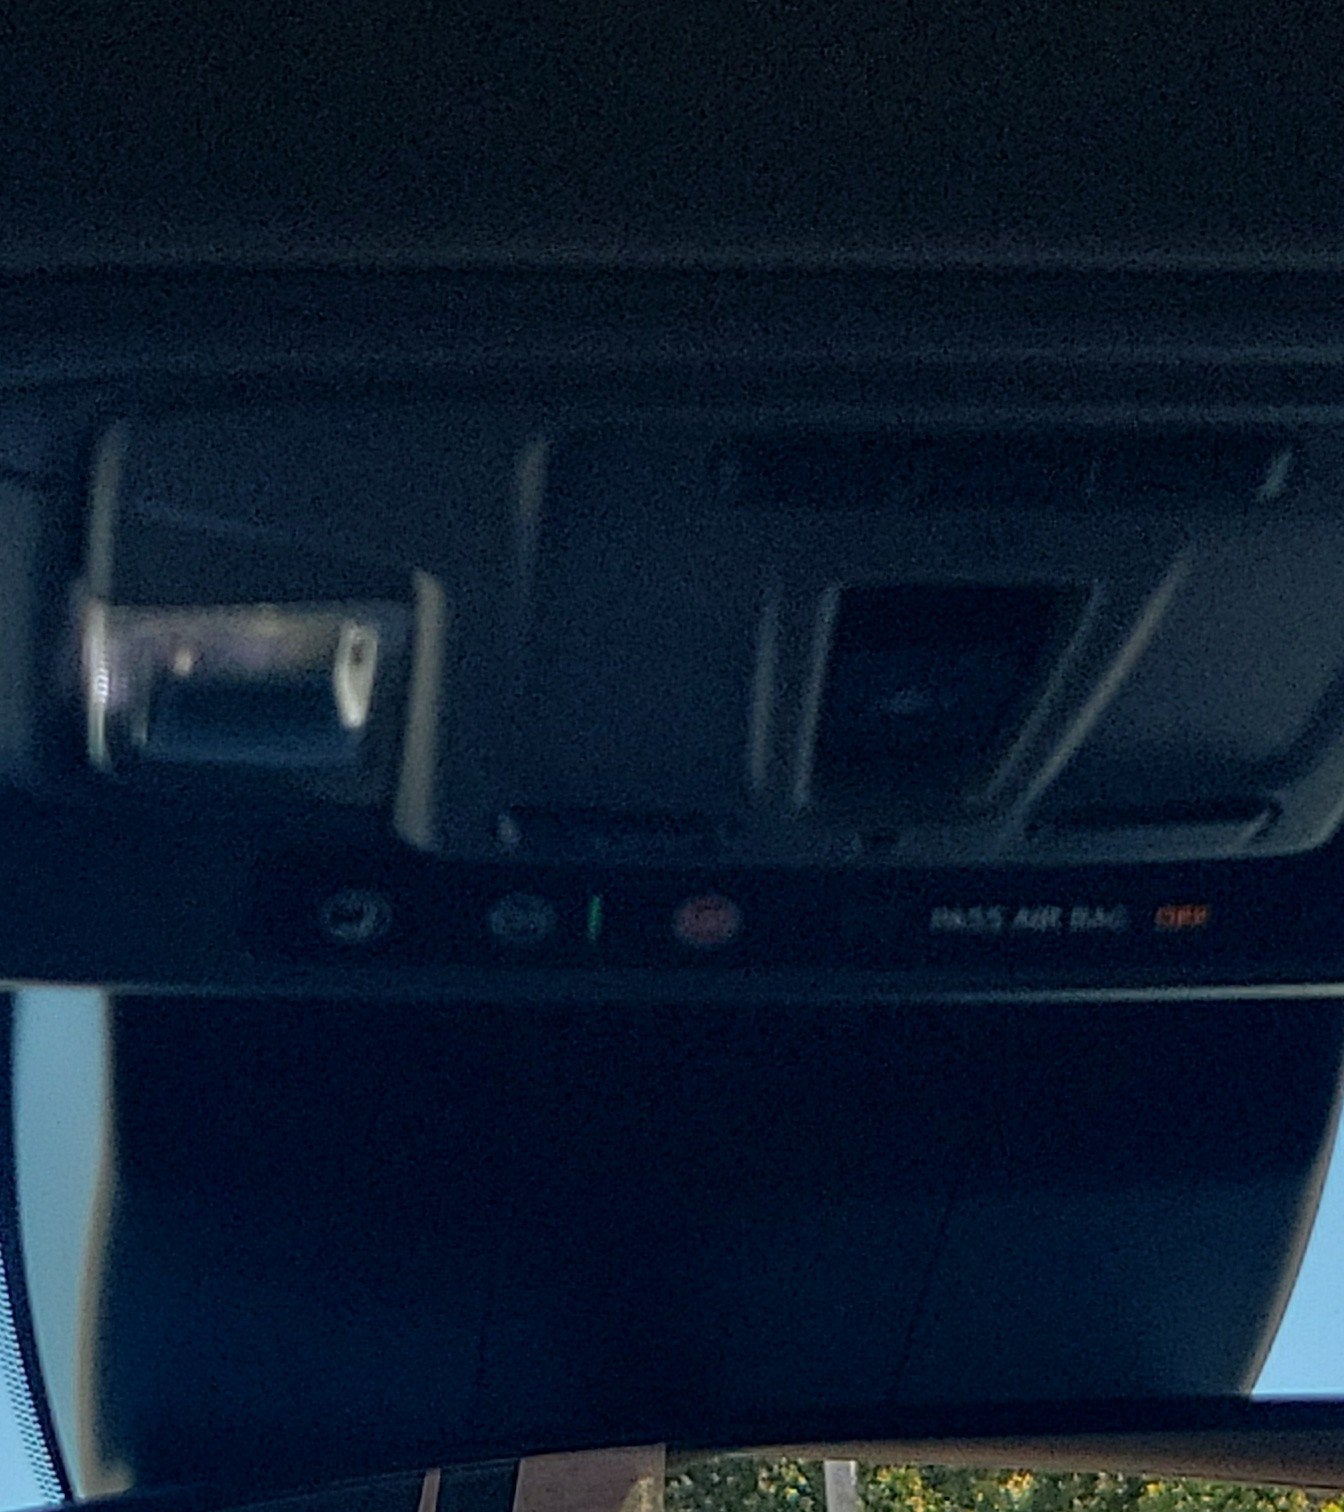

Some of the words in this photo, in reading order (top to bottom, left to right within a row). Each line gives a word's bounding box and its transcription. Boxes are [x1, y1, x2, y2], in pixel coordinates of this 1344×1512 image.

[930, 905, 1006, 931] PASS
[1013, 905, 1062, 930] AIR
[1155, 904, 1209, 930] OFF
